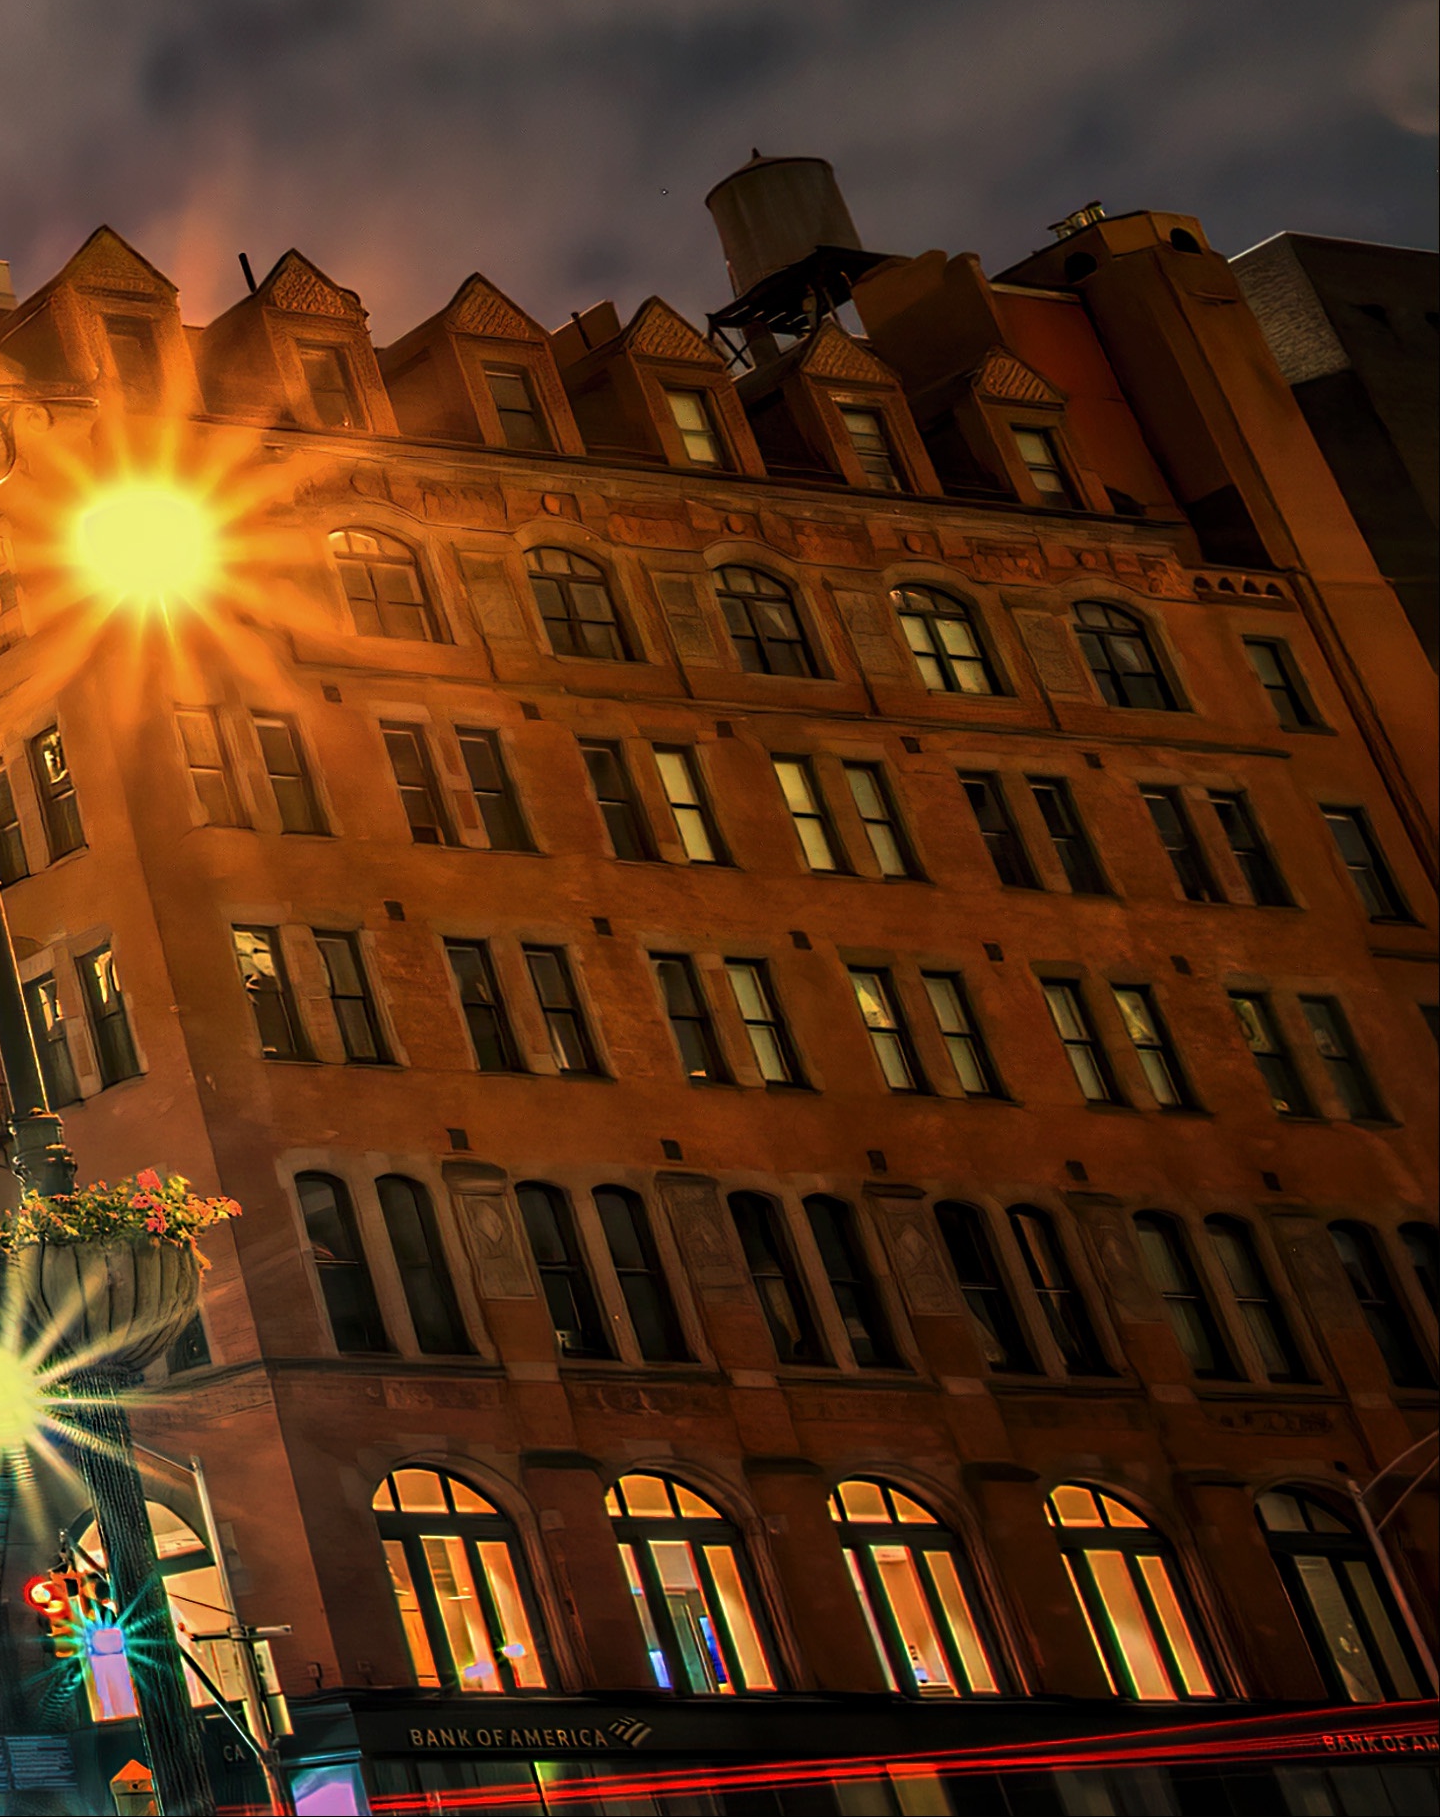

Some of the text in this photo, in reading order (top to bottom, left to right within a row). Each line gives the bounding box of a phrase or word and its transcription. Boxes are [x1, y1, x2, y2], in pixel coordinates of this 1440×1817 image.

[409, 1728, 610, 1748] BANK OF AMERICA
[1322, 1735, 1381, 1752] BANK
